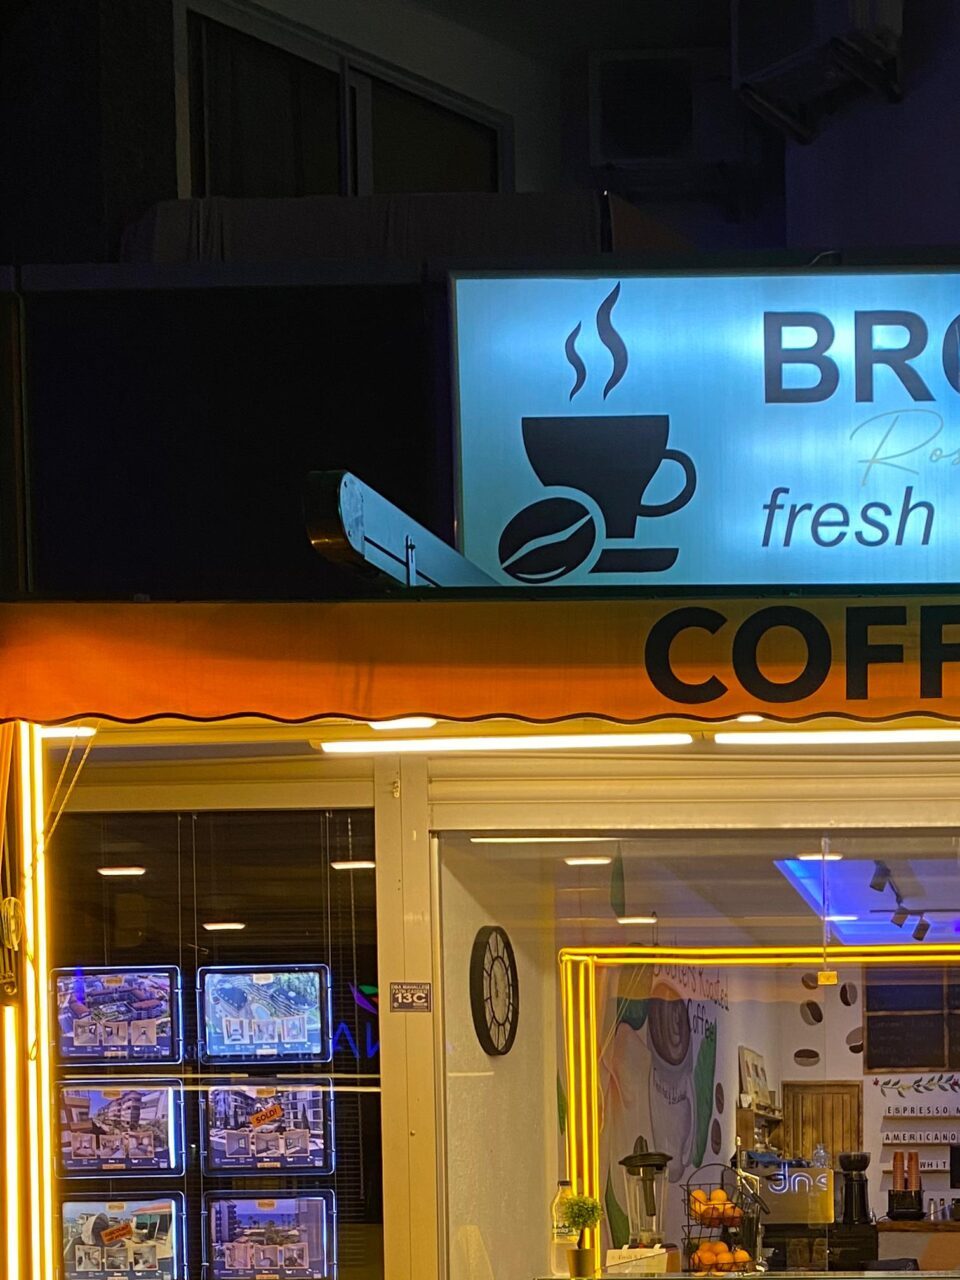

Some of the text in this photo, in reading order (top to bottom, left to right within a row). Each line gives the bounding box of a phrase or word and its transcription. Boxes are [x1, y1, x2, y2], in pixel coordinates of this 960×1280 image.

[760, 486, 933, 549] fresh
[394, 992, 426, 1004] 13C
[887, 1106, 948, 1115] ESPRESSO
[885, 1133, 956, 1142] AMERICANO
